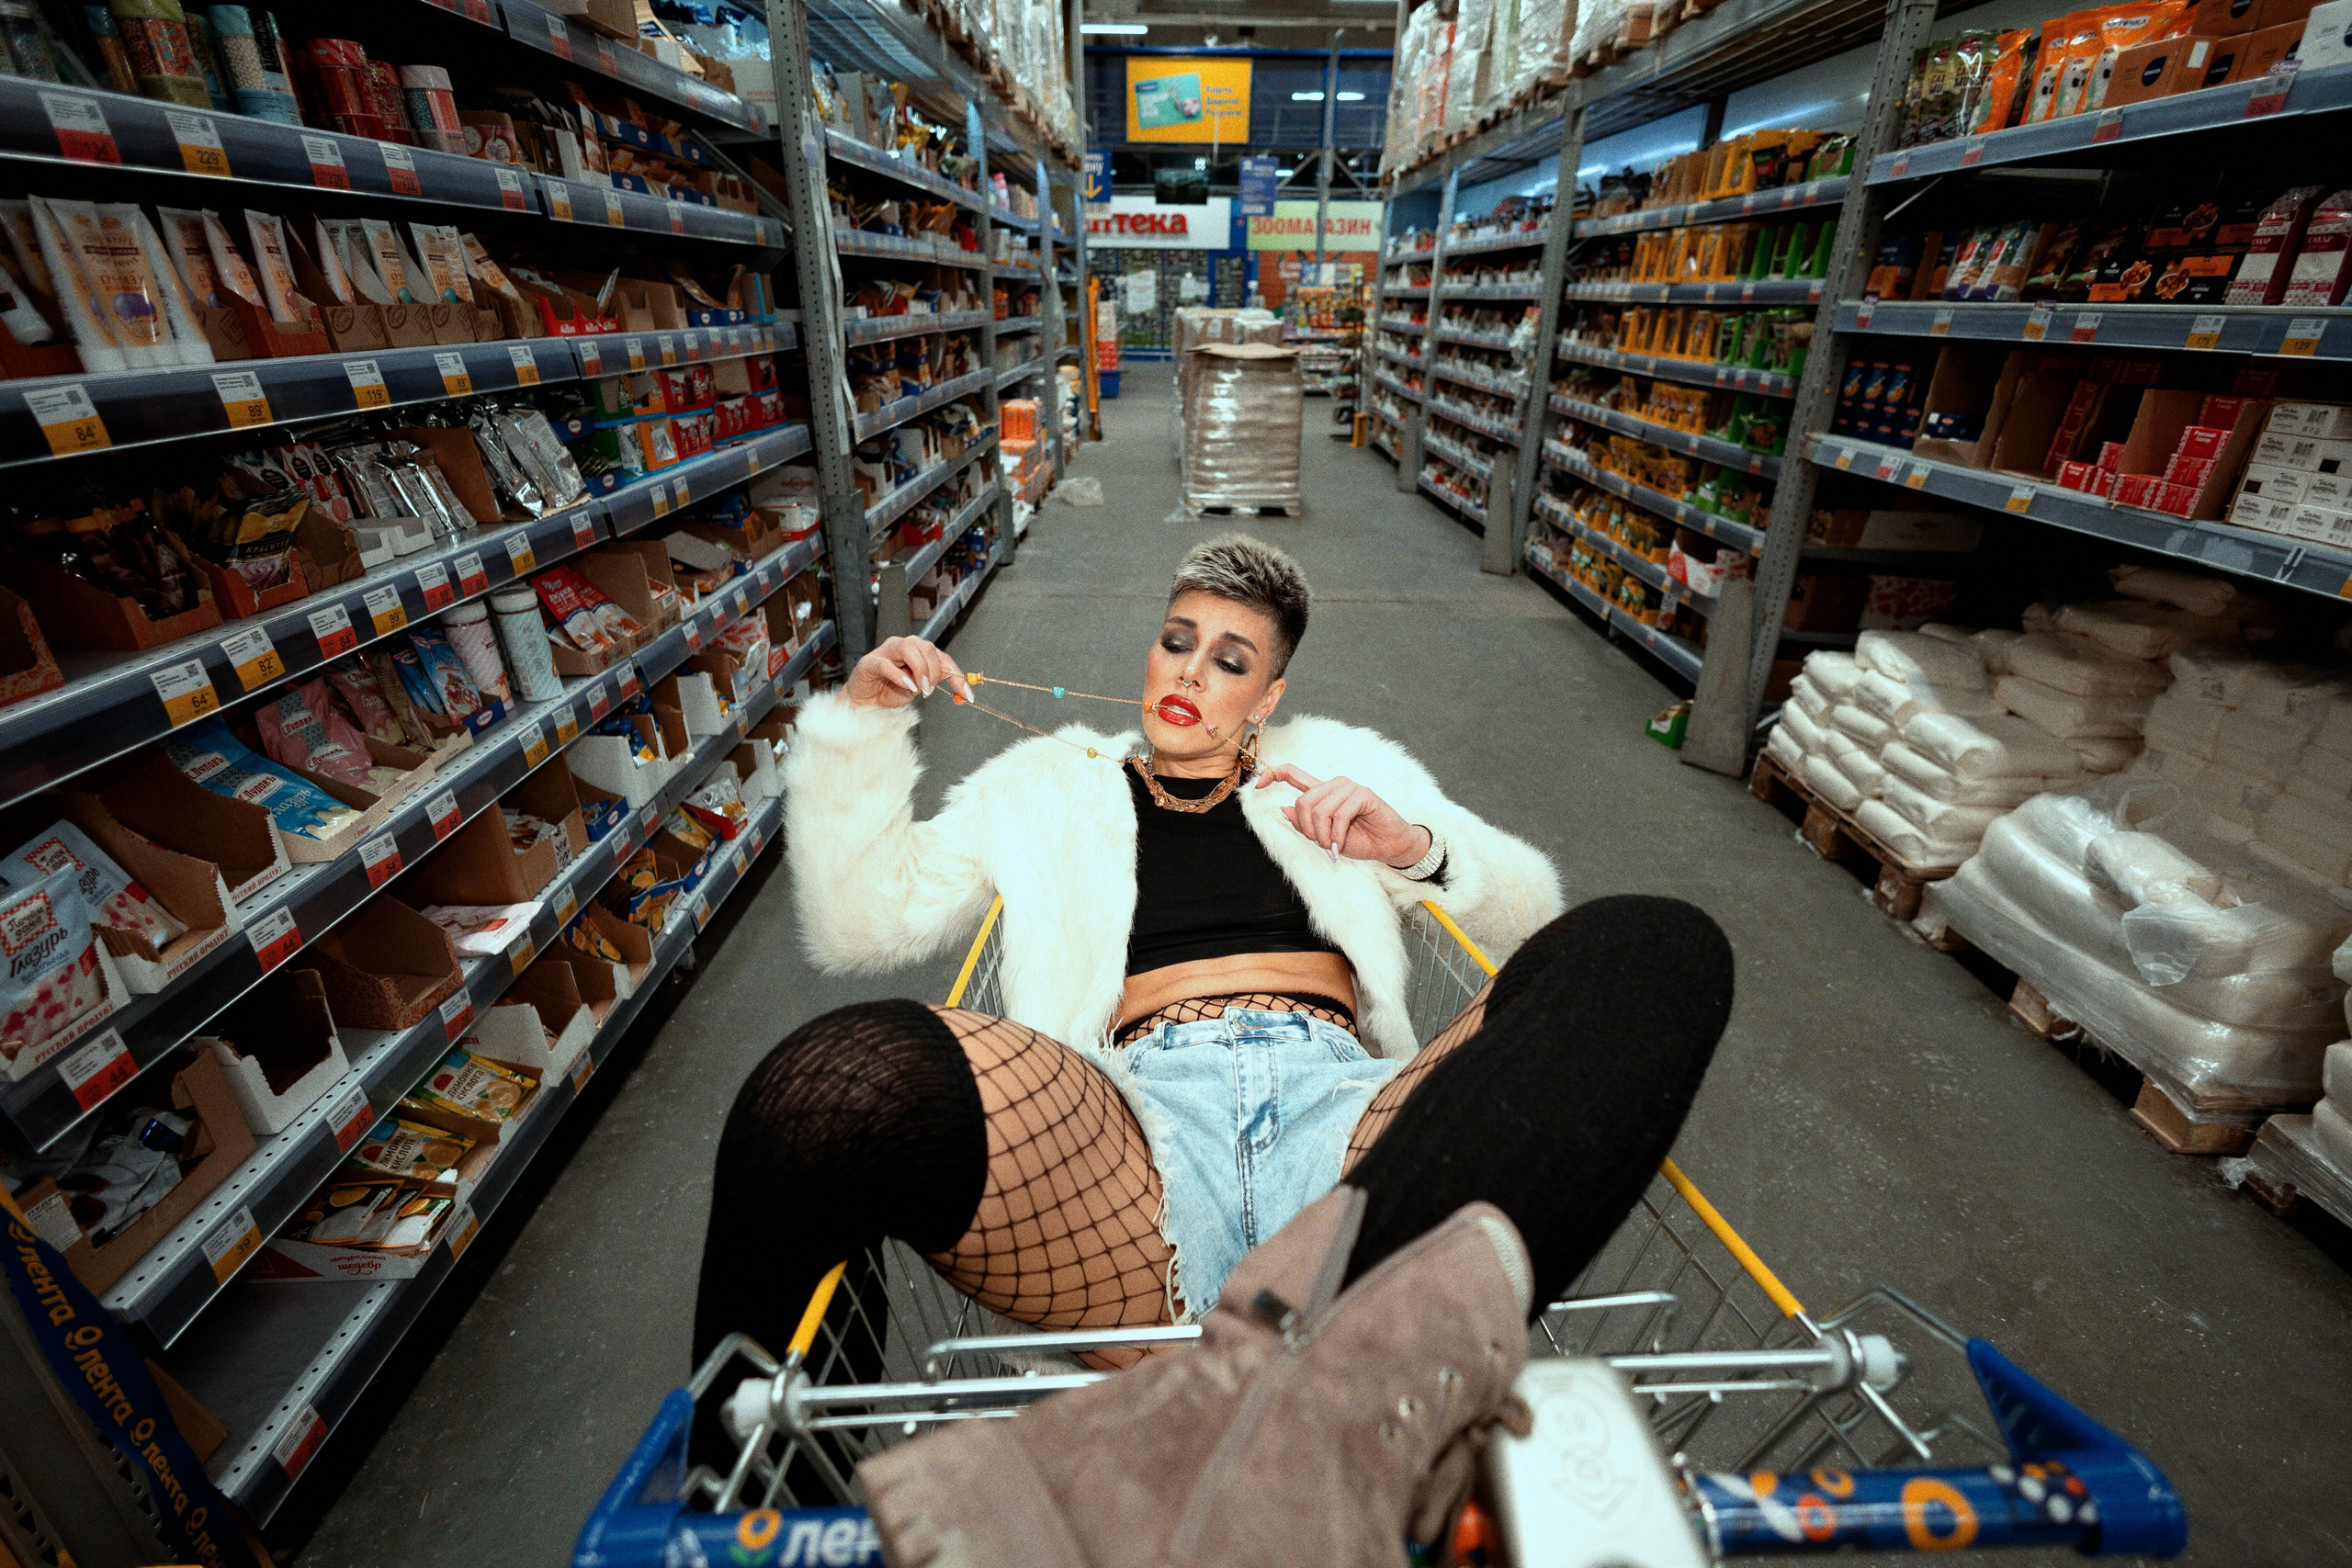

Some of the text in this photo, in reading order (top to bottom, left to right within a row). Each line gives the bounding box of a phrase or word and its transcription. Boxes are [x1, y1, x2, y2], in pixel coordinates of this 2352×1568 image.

[197, 150, 219, 165] 229
[1252, 218, 1371, 235] ЗООМААЗИН
[367, 389, 383, 401] 119
[248, 405, 262, 418] 89
[75, 425, 95, 442] 84
[245, 541, 289, 555] КРАСИТЕ
[258, 658, 274, 672] 82
[191, 694, 209, 708] 64
[9, 927, 69, 979] Глазурь
[282, 938, 296, 953] 44
[166, 930, 230, 980] РУССКИЙ ПРОДУКТ
[34, 1003, 114, 1064] РУССКИЙ ПРОДУКТ
[109, 1065, 127, 1083] 44
[236, 1237, 251, 1256] 39
[330, 1254, 387, 1264] натуральный
[337, 1260, 382, 1276] шедевр
[17, 1245, 75, 1326] лента
[74, 1348, 133, 1427] лента
[141, 1441, 188, 1517] лента
[192, 1530, 227, 1568] лен
[780, 1517, 882, 1567] лен
